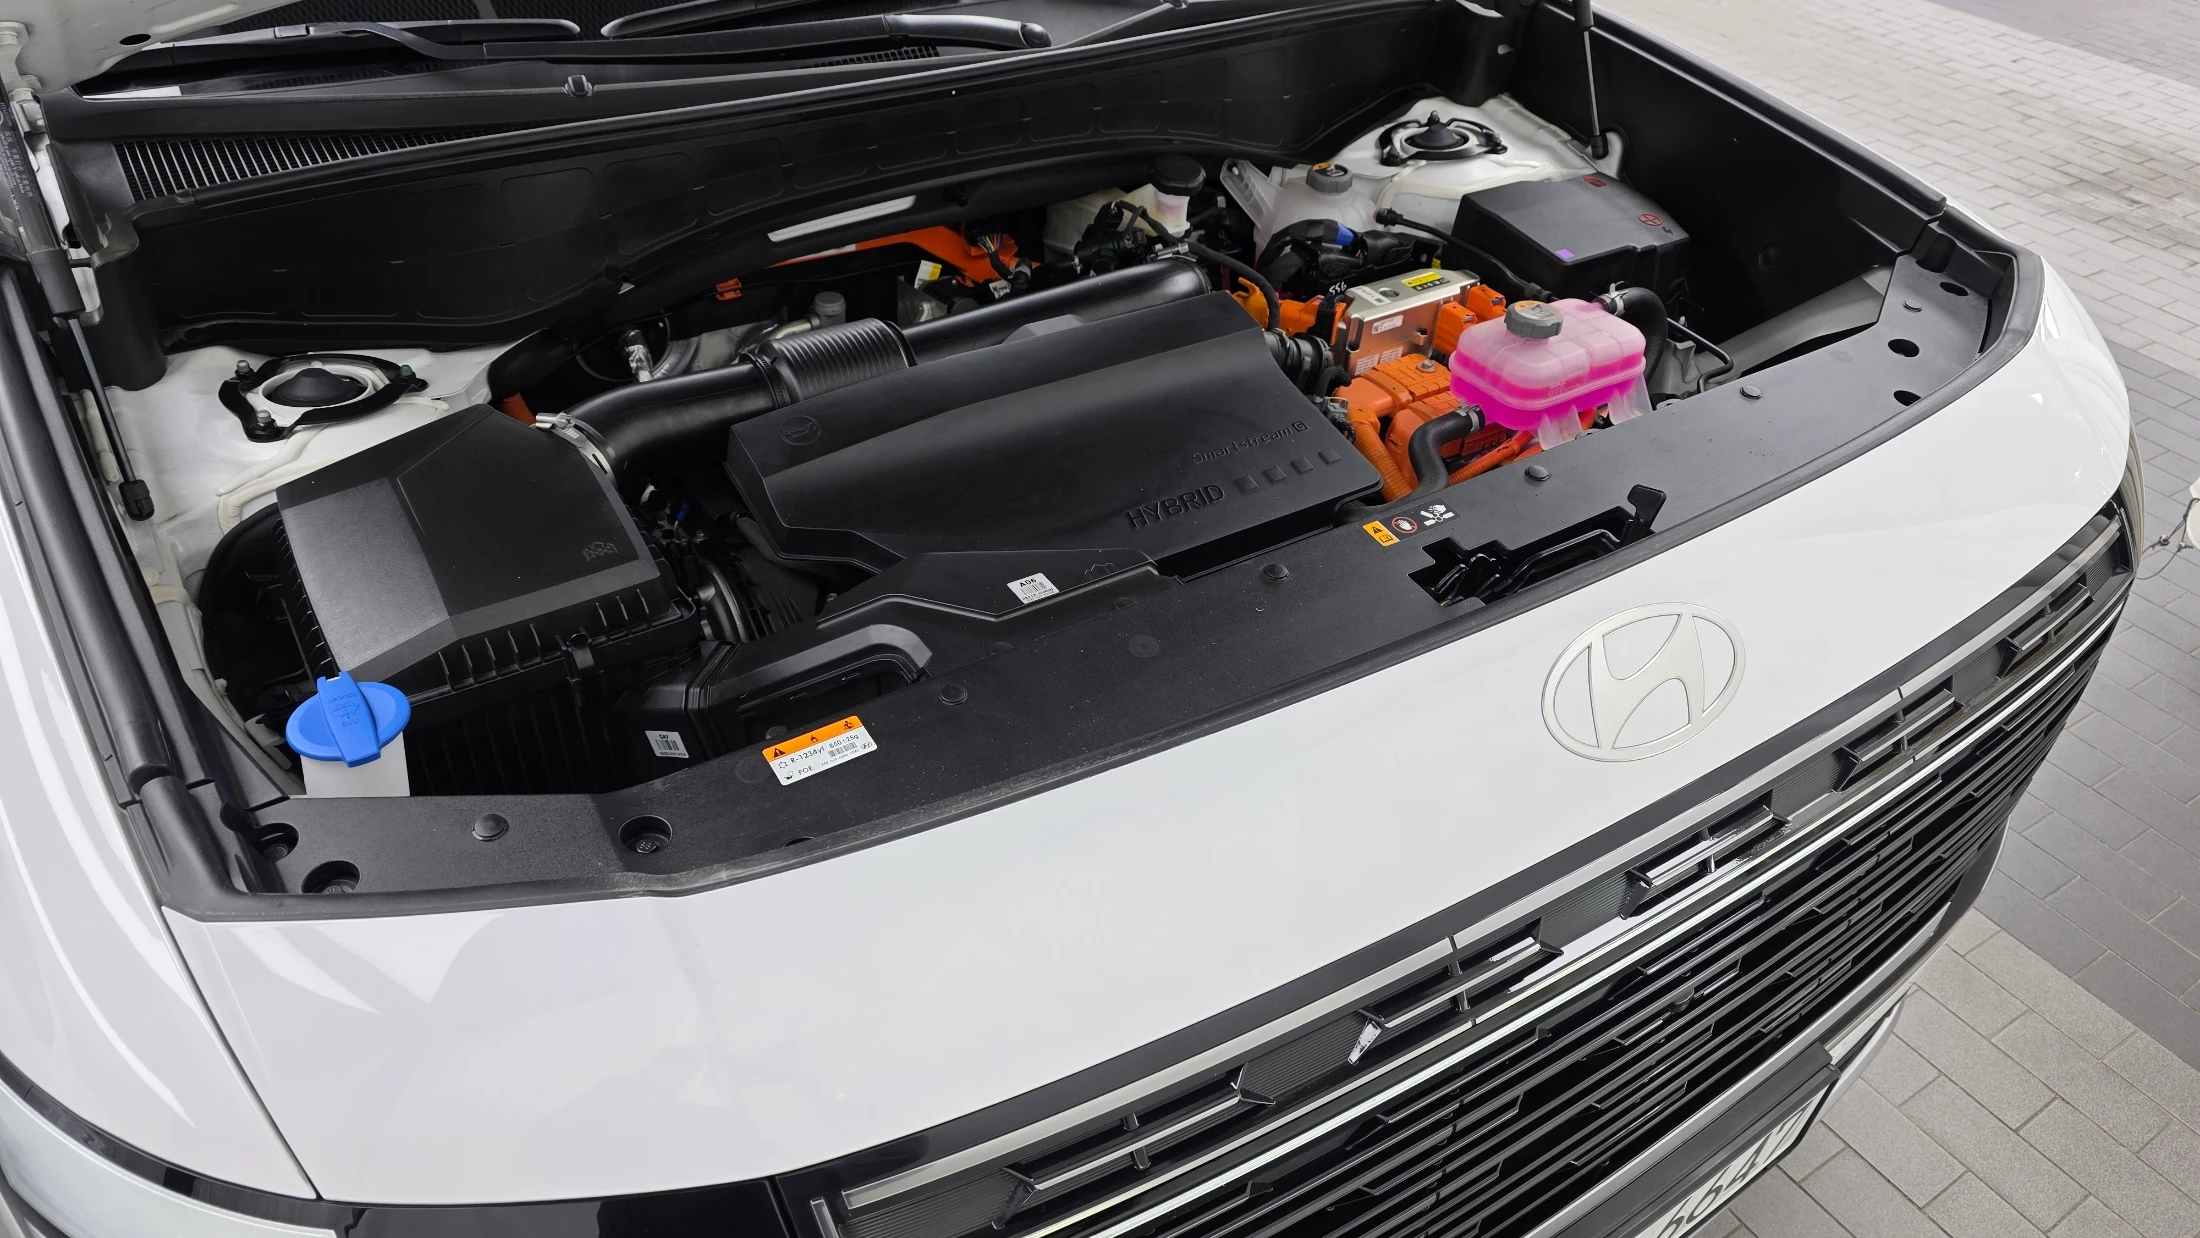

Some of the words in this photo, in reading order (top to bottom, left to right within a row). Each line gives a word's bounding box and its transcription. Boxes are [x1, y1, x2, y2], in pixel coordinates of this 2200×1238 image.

[1192, 426, 1293, 464] Smartstream
[1126, 484, 1225, 530] HYBRID
[790, 746, 826, 763] R-1234yf
[798, 765, 814, 775] POE
